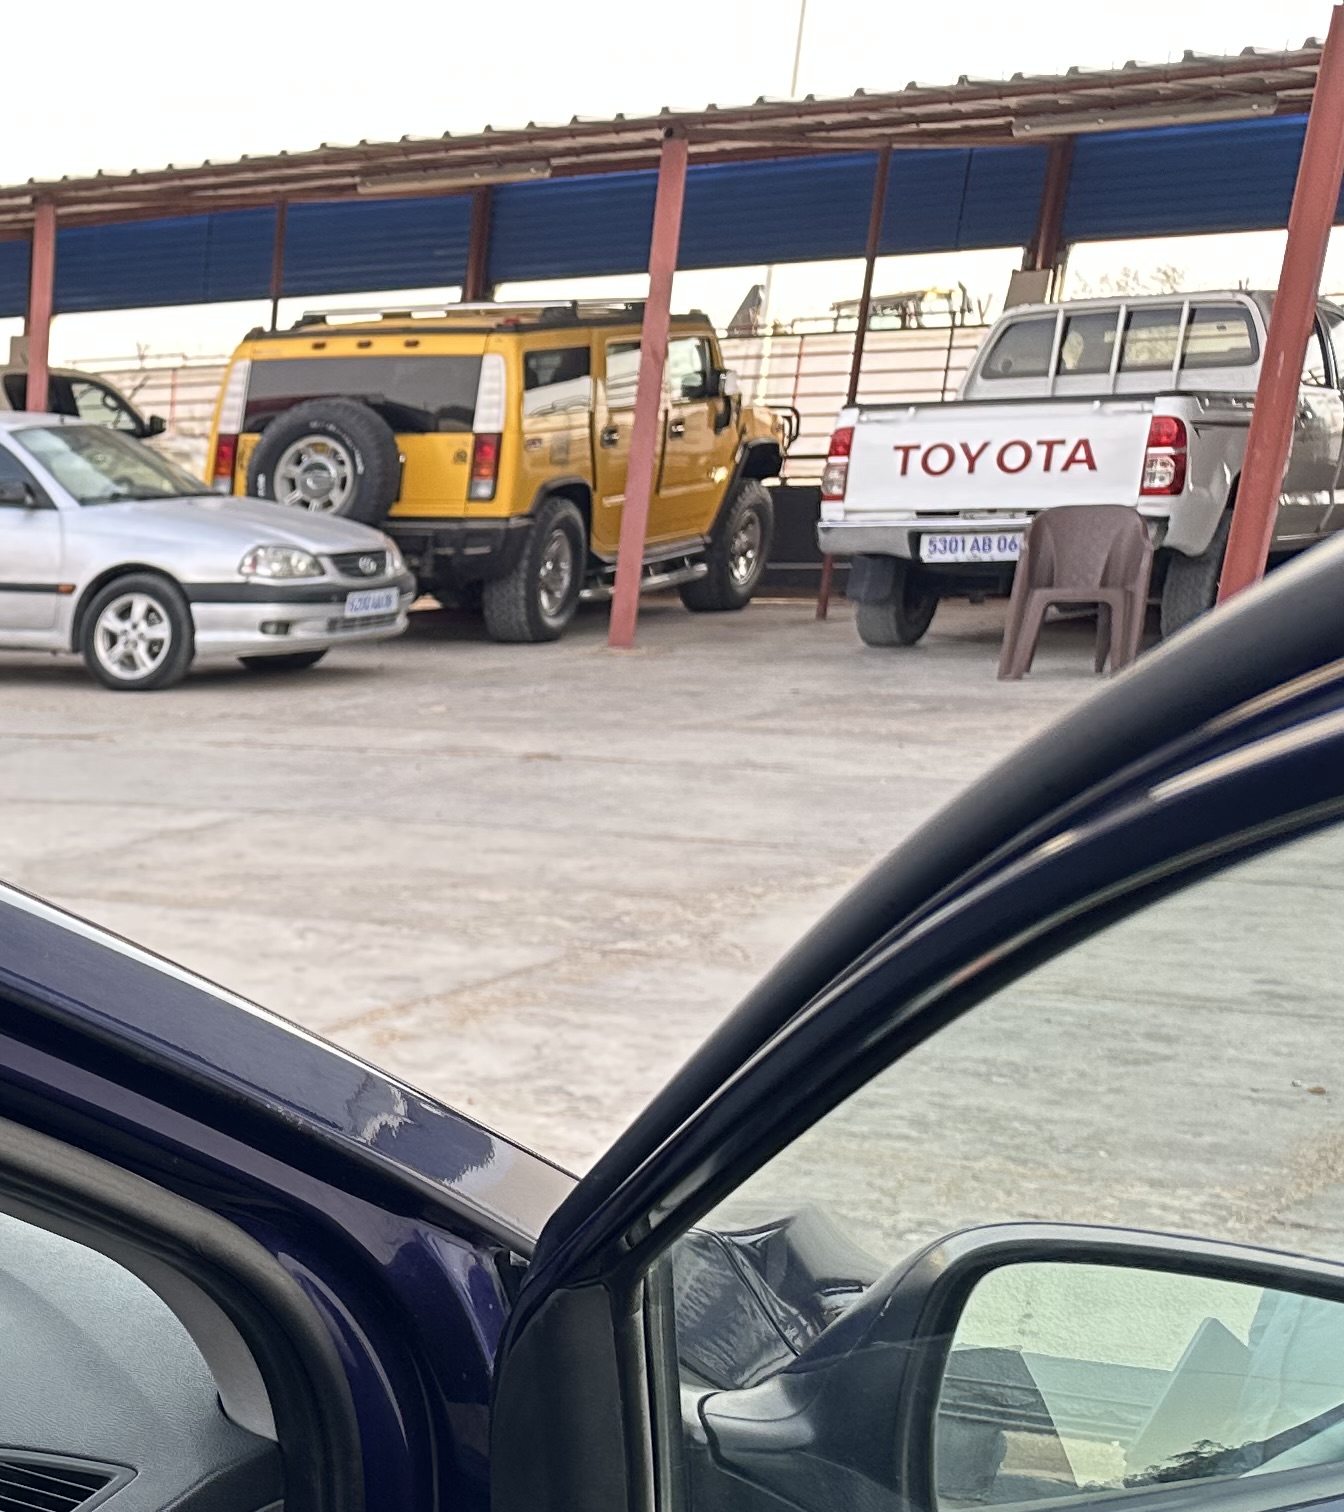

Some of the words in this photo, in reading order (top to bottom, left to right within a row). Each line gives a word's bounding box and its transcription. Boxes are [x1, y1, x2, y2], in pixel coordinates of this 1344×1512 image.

[893, 438, 1098, 477] TOYOTA
[927, 535, 965, 555] 5301
[970, 535, 993, 553] AB
